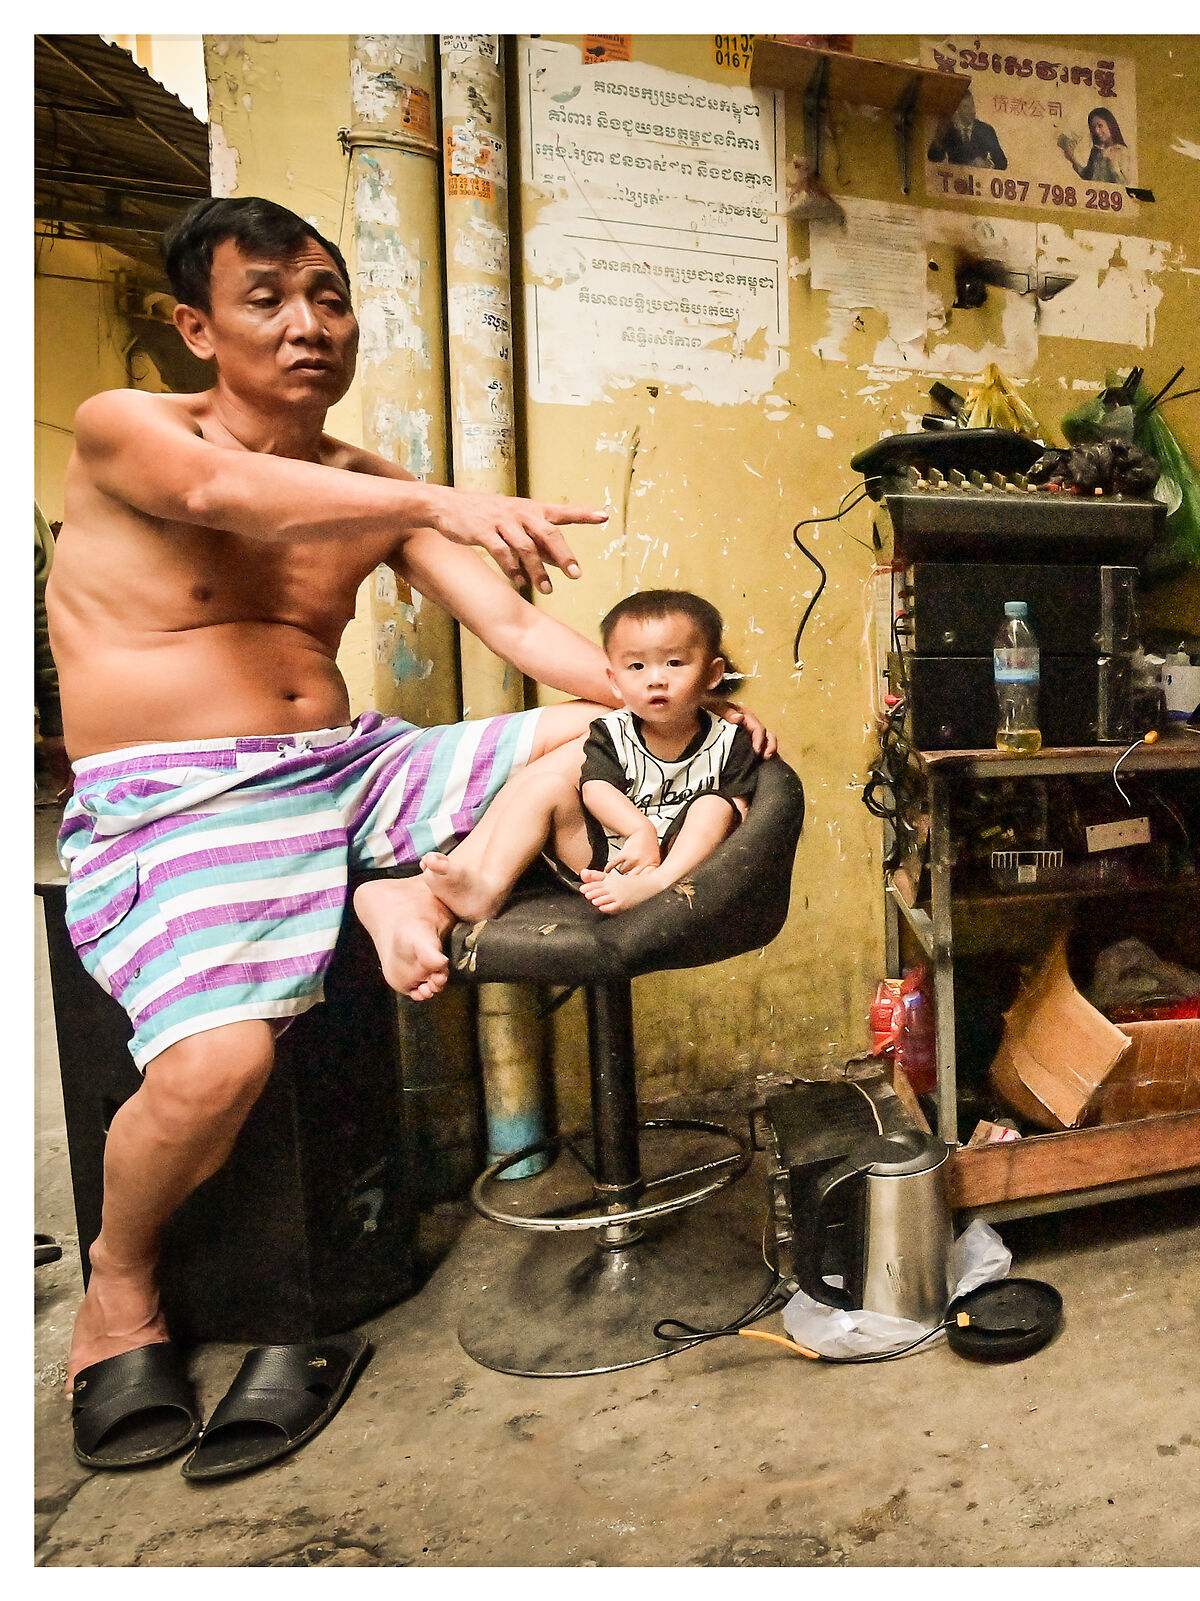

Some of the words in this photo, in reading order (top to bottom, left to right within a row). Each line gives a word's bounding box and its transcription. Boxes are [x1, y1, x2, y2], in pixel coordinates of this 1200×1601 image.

[938, 171, 981, 196] Tel:
[990, 177, 1030, 201] 087
[1038, 183, 1077, 207] 798
[1085, 188, 1123, 212] 289
